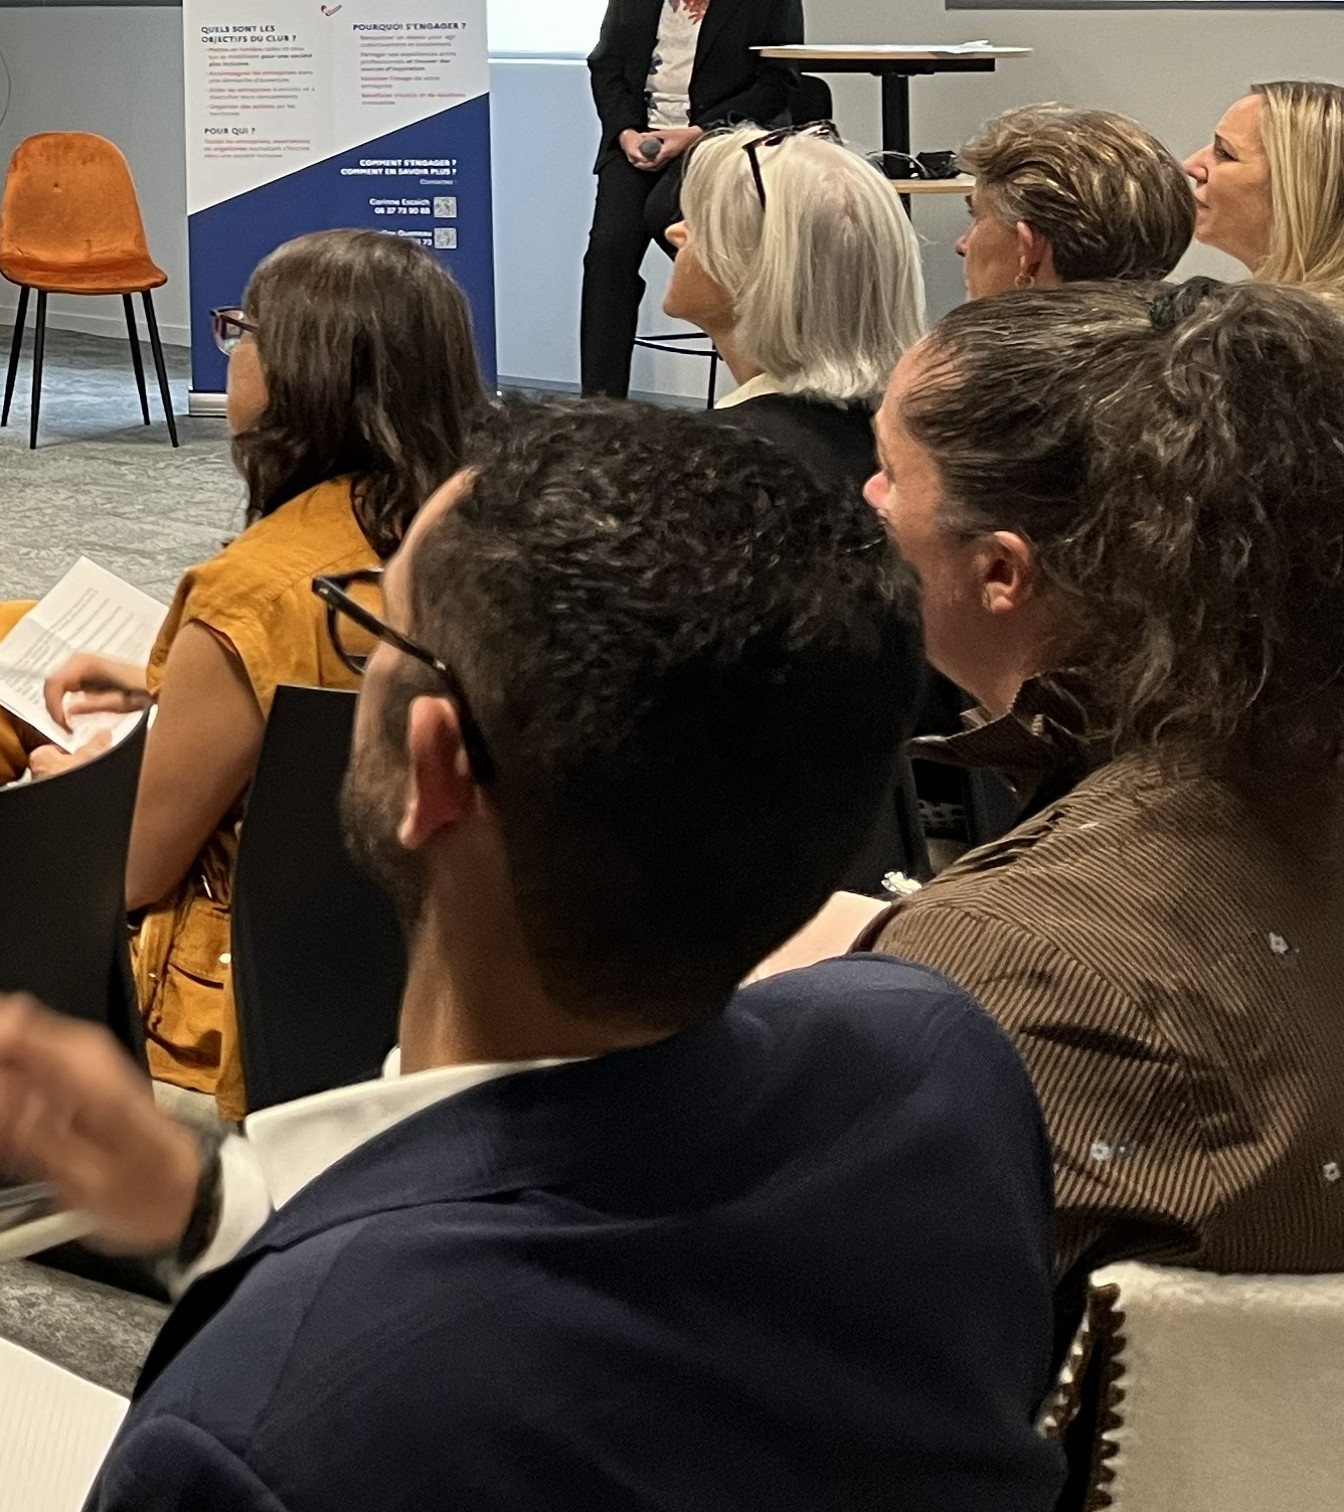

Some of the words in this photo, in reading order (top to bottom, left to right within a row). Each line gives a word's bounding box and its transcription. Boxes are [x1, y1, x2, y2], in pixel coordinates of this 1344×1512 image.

[201, 26, 230, 34] QUELS
[232, 25, 257, 33] SONT
[353, 23, 404, 31] POURQUOI
[201, 35, 248, 44] OBJECTIFS
[266, 34, 290, 42] CLUB
[231, 127, 249, 136] QUI
[359, 159, 402, 167] COMMENT
